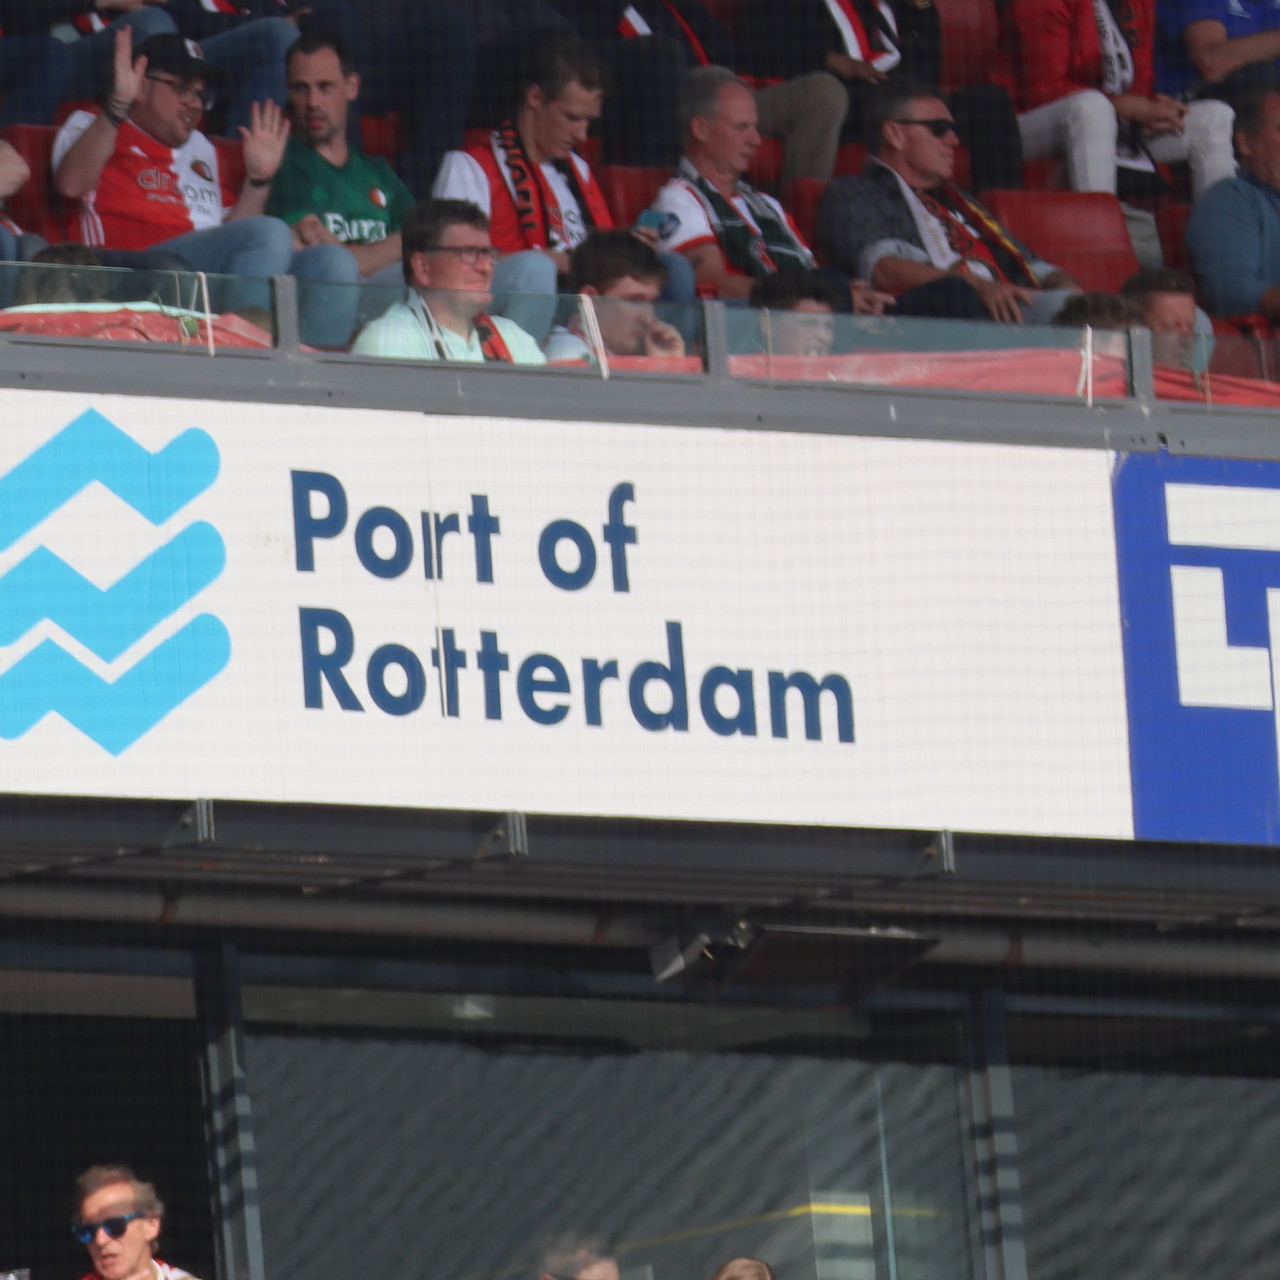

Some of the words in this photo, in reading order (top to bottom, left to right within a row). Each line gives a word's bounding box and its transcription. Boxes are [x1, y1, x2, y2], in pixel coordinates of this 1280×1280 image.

[289, 469, 501, 584] Port
[537, 481, 639, 594] of
[298, 606, 856, 744] Rotterdam
